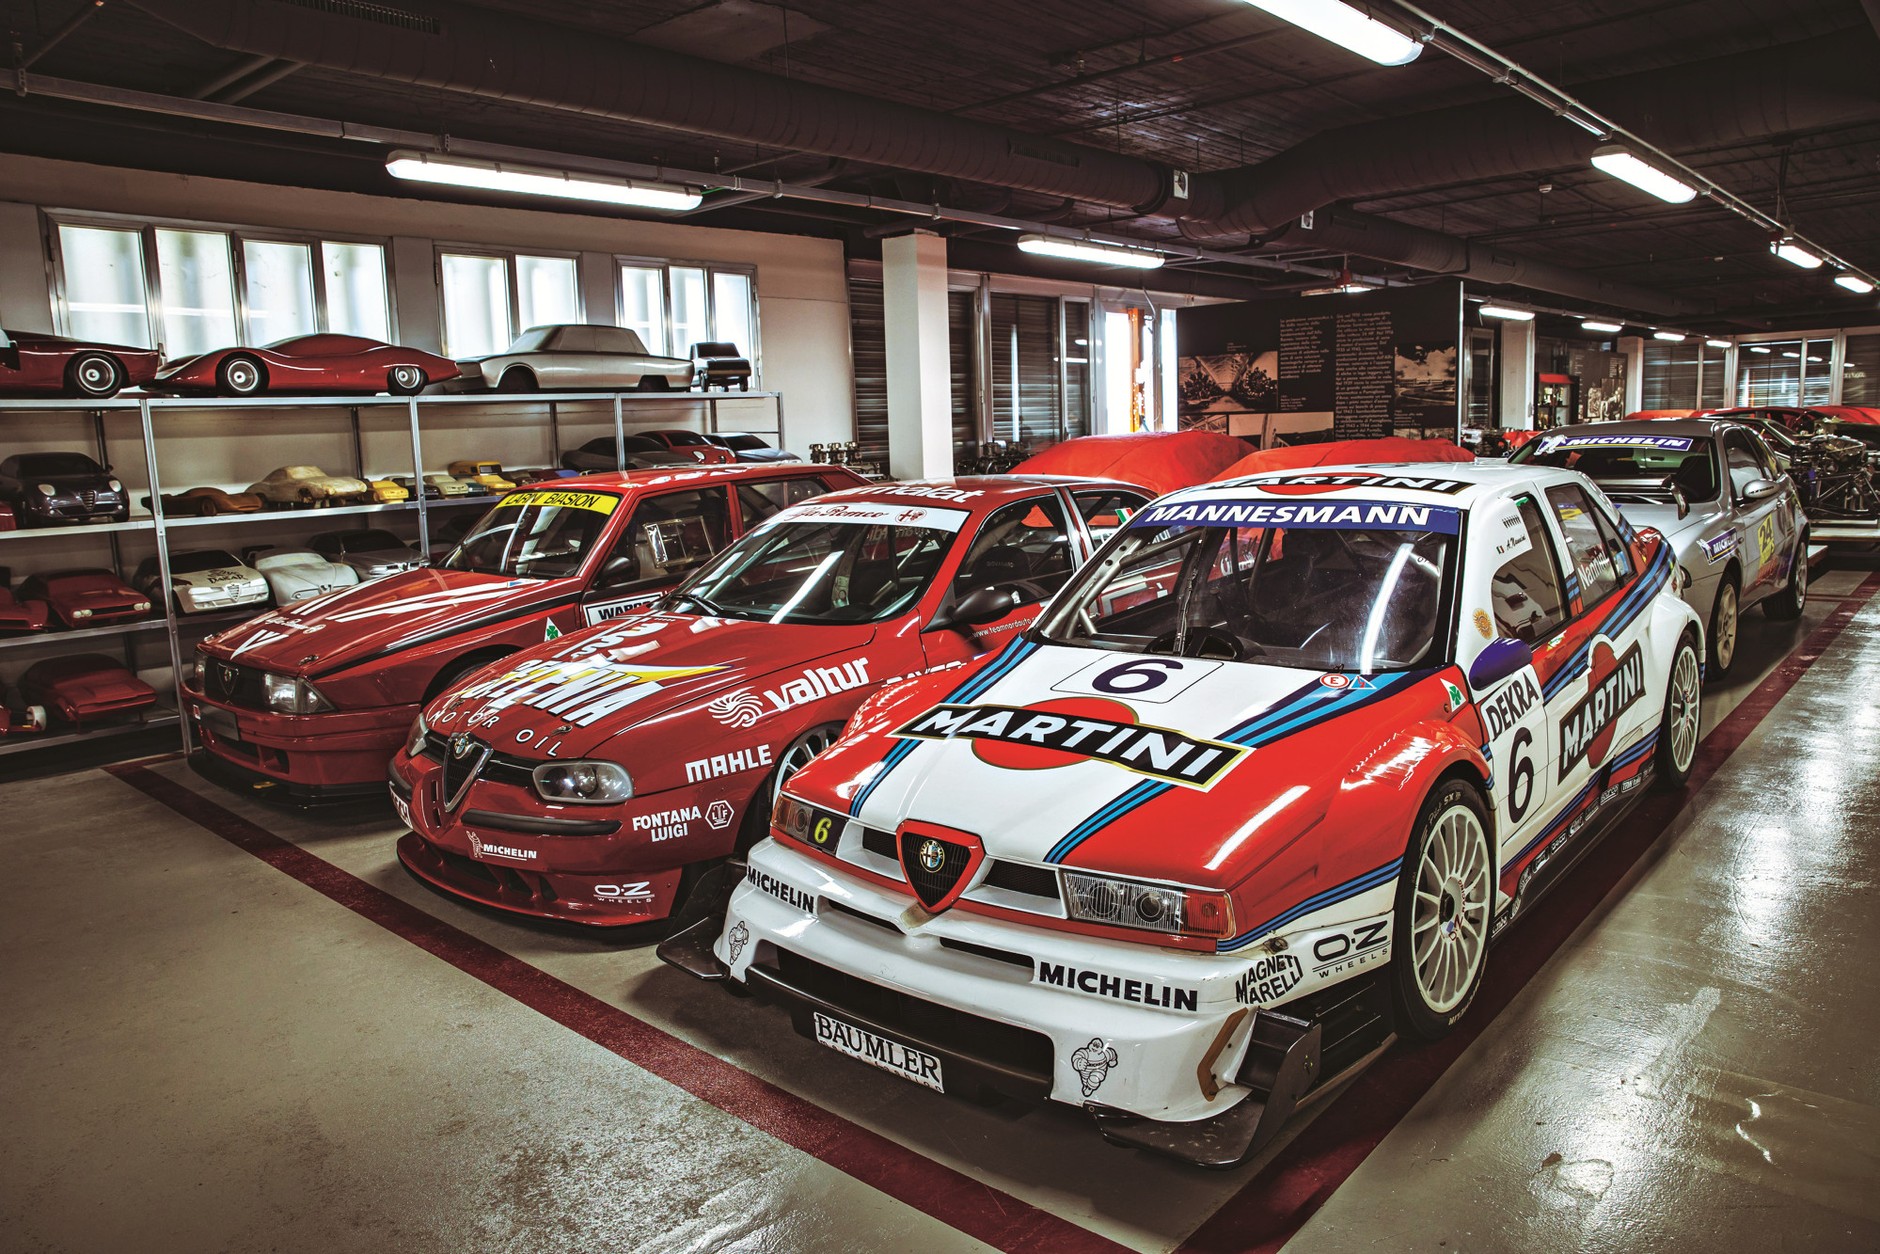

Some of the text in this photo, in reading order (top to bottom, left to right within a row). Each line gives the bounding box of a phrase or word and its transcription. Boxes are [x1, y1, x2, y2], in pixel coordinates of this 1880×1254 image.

[1570, 436, 1688, 447] MICHELIN
[543, 493, 600, 508] BIASION
[821, 505, 889, 518] Romeo
[1145, 504, 1432, 526] MANNESMANN
[763, 657, 870, 712] valtur
[1092, 658, 1184, 694] 6
[1330, 676, 1340, 685] E
[1486, 672, 1540, 742] DEKRA
[1563, 652, 1642, 770] MARTINI
[428, 710, 564, 757] MOTOR OIL
[911, 708, 1223, 777] MARTINI
[685, 744, 773, 784] MAHLE
[1508, 726, 1535, 824] 6
[632, 806, 702, 831] FONTANA
[650, 822, 688, 843] LUIGI
[814, 817, 832, 844] 6
[483, 843, 537, 859] MICHELIN
[747, 865, 815, 914] MICHELIN
[1235, 955, 1304, 1004] MAGNETI
[1318, 948, 1389, 978] WHEELS
[1039, 961, 1198, 1012] MICHELIN
[1235, 971, 1304, 1004] MARELLI
[815, 1013, 941, 1084] BÄUMLER
